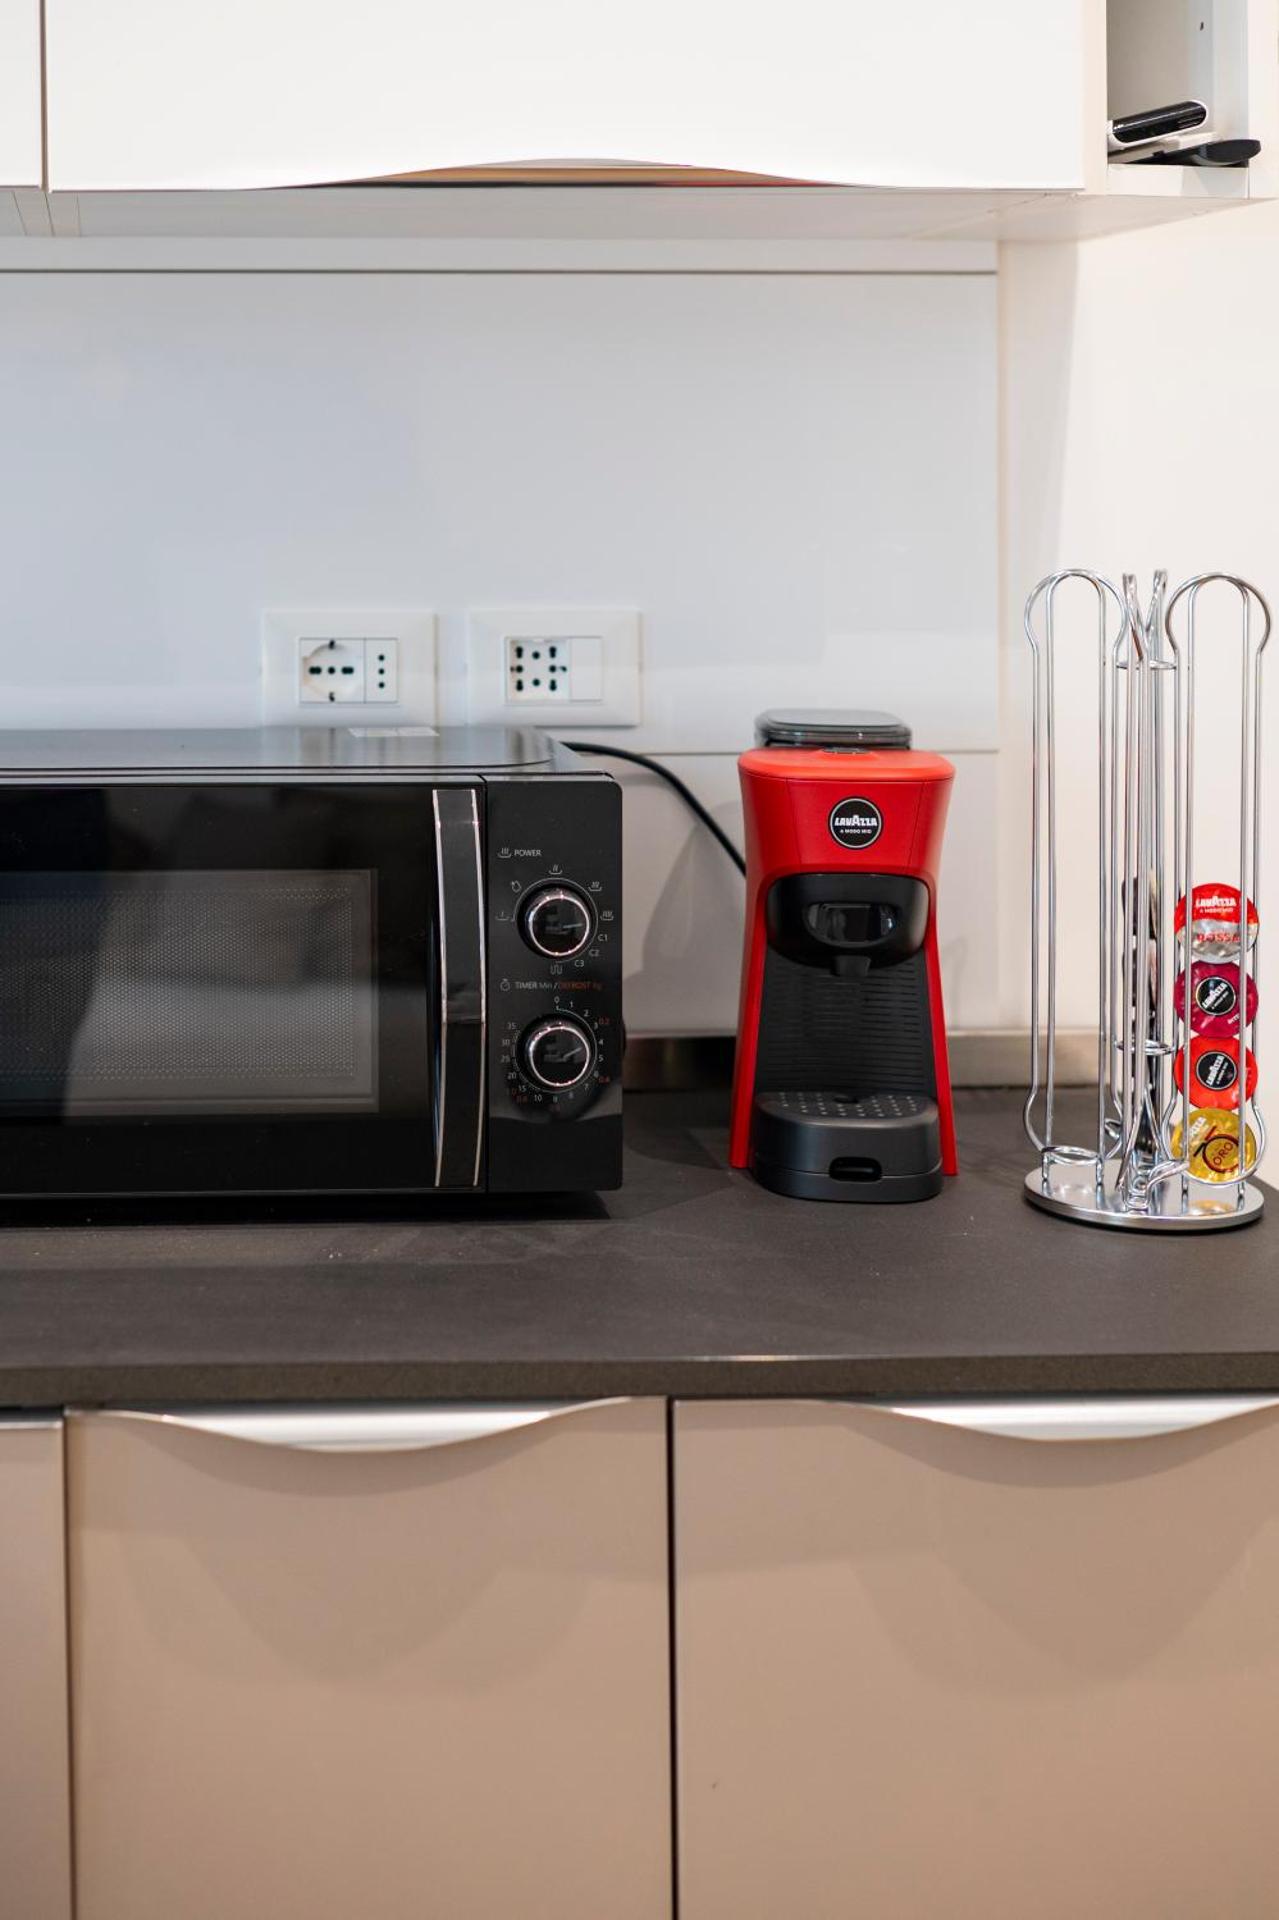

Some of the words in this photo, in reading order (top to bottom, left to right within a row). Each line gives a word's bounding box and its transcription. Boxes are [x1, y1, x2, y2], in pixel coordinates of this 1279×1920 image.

[834, 814, 878, 827] LAVAZZA
[514, 849, 542, 857] POWER
[1195, 895, 1237, 907] LAVAZZA
[597, 933, 608, 942] C1
[589, 949, 600, 957] C2
[574, 959, 585, 968] C3
[515, 981, 538, 990] TIMER
[584, 1009, 590, 1017] 2
[534, 1093, 543, 1103] 10
[1212, 1141, 1234, 1166] ORO
